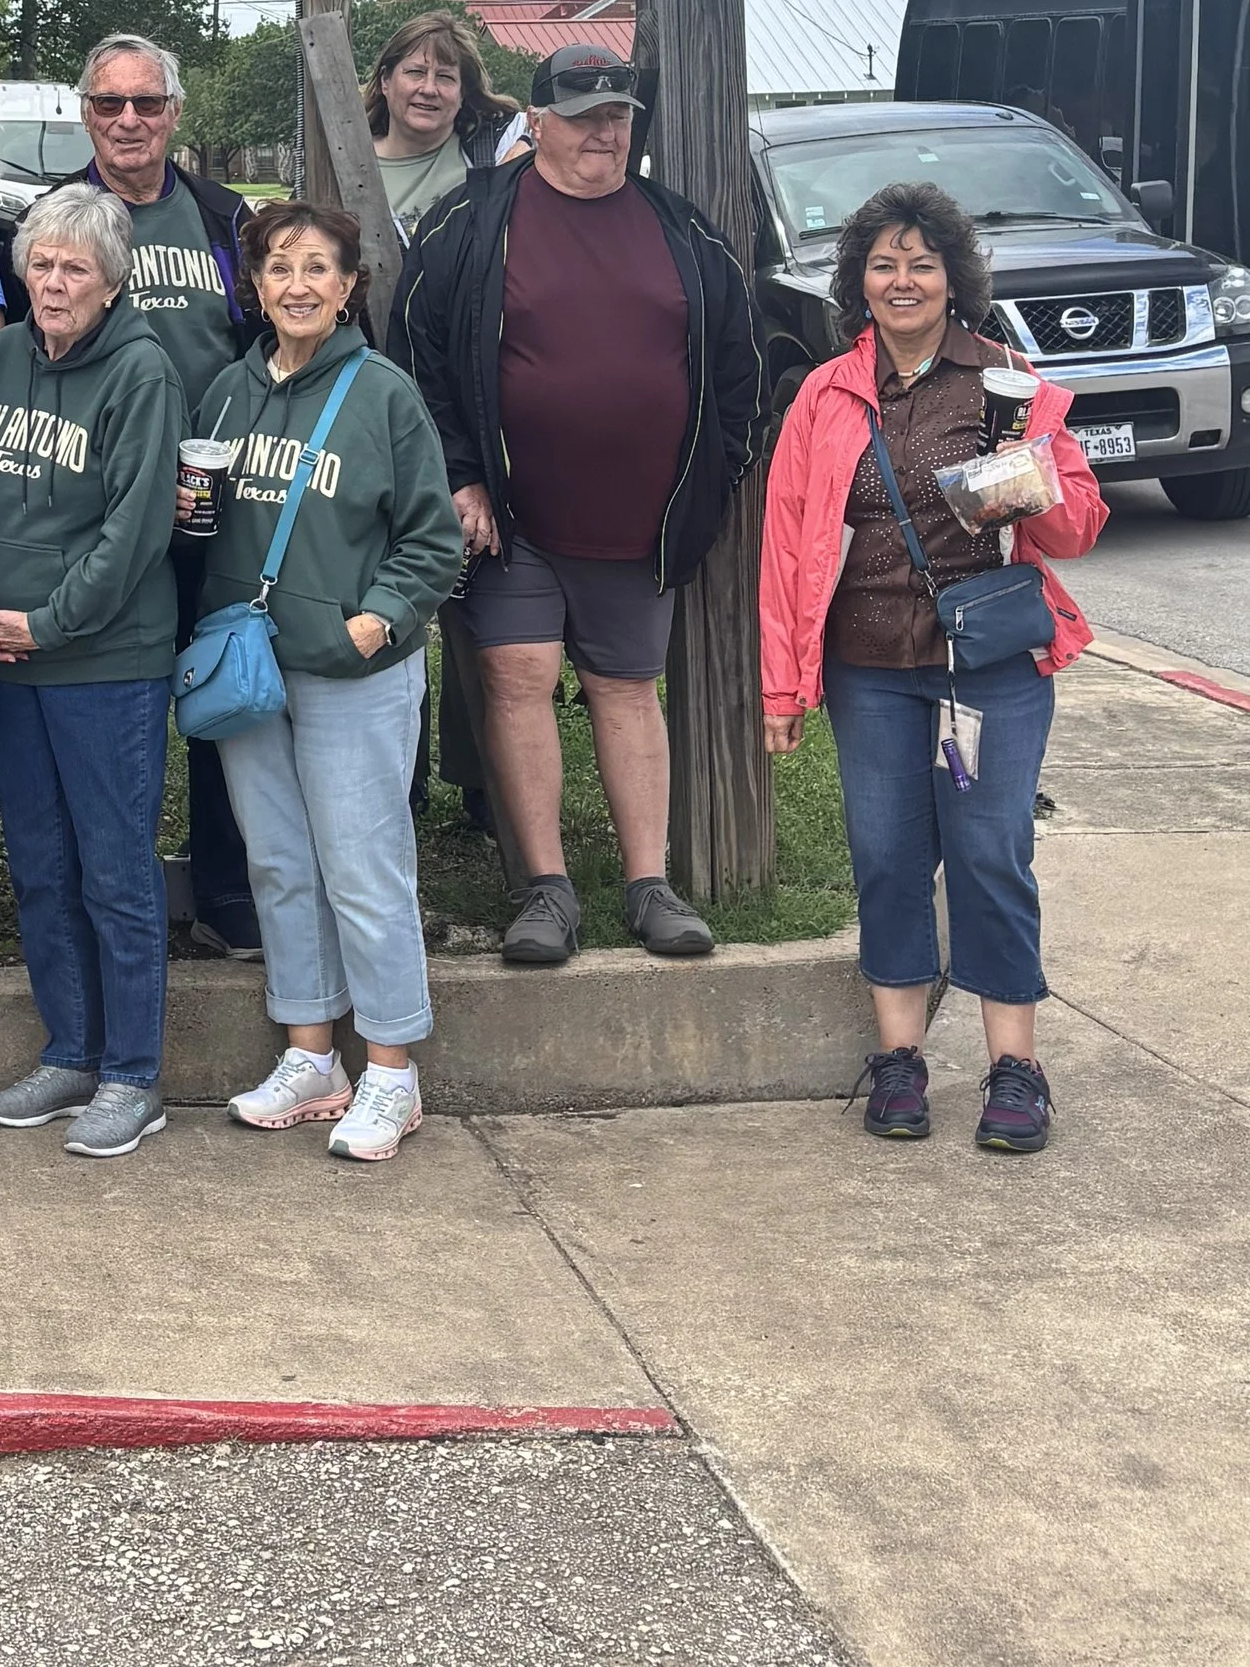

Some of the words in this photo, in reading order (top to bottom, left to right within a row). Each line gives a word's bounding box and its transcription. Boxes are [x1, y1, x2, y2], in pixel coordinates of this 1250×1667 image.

[129, 290, 189, 311] Texas
[1083, 427, 1113, 437] TEXAS
[1099, 436, 1132, 456] 8953
